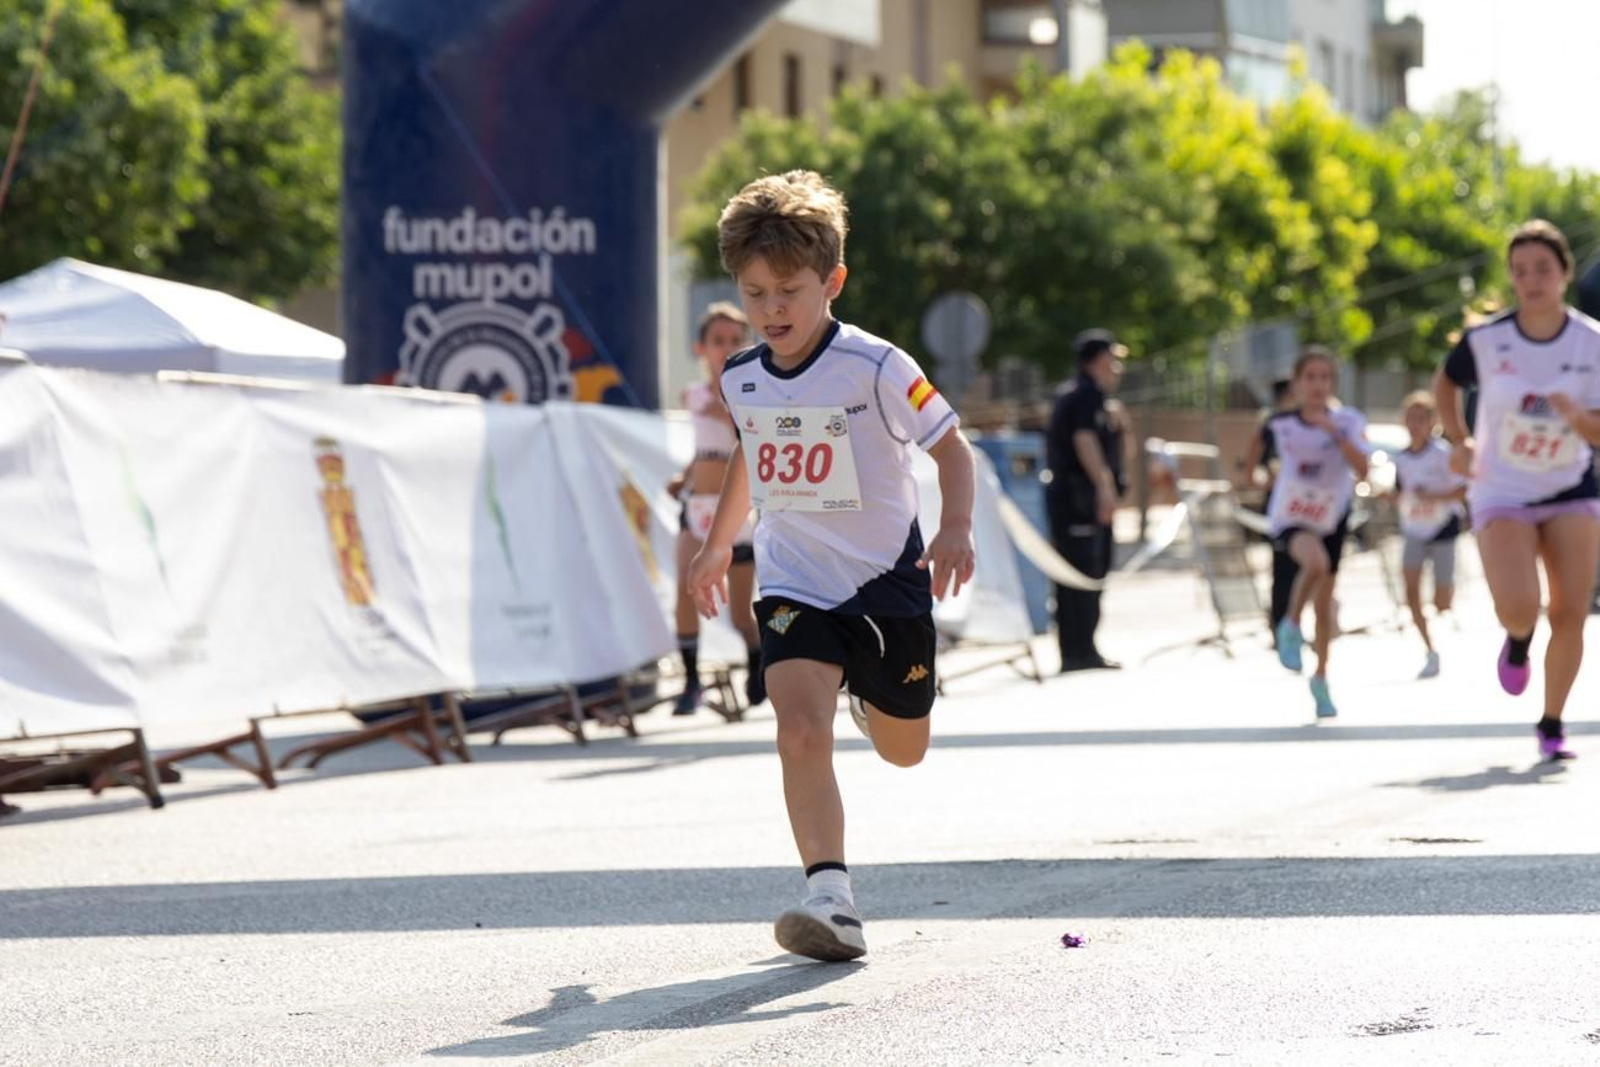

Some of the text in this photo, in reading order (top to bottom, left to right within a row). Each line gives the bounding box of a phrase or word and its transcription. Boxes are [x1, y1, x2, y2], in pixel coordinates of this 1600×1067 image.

[383, 206, 597, 254] fundación
[413, 253, 552, 308] mupol
[757, 442, 833, 484] 830
[1509, 432, 1563, 460] 821
